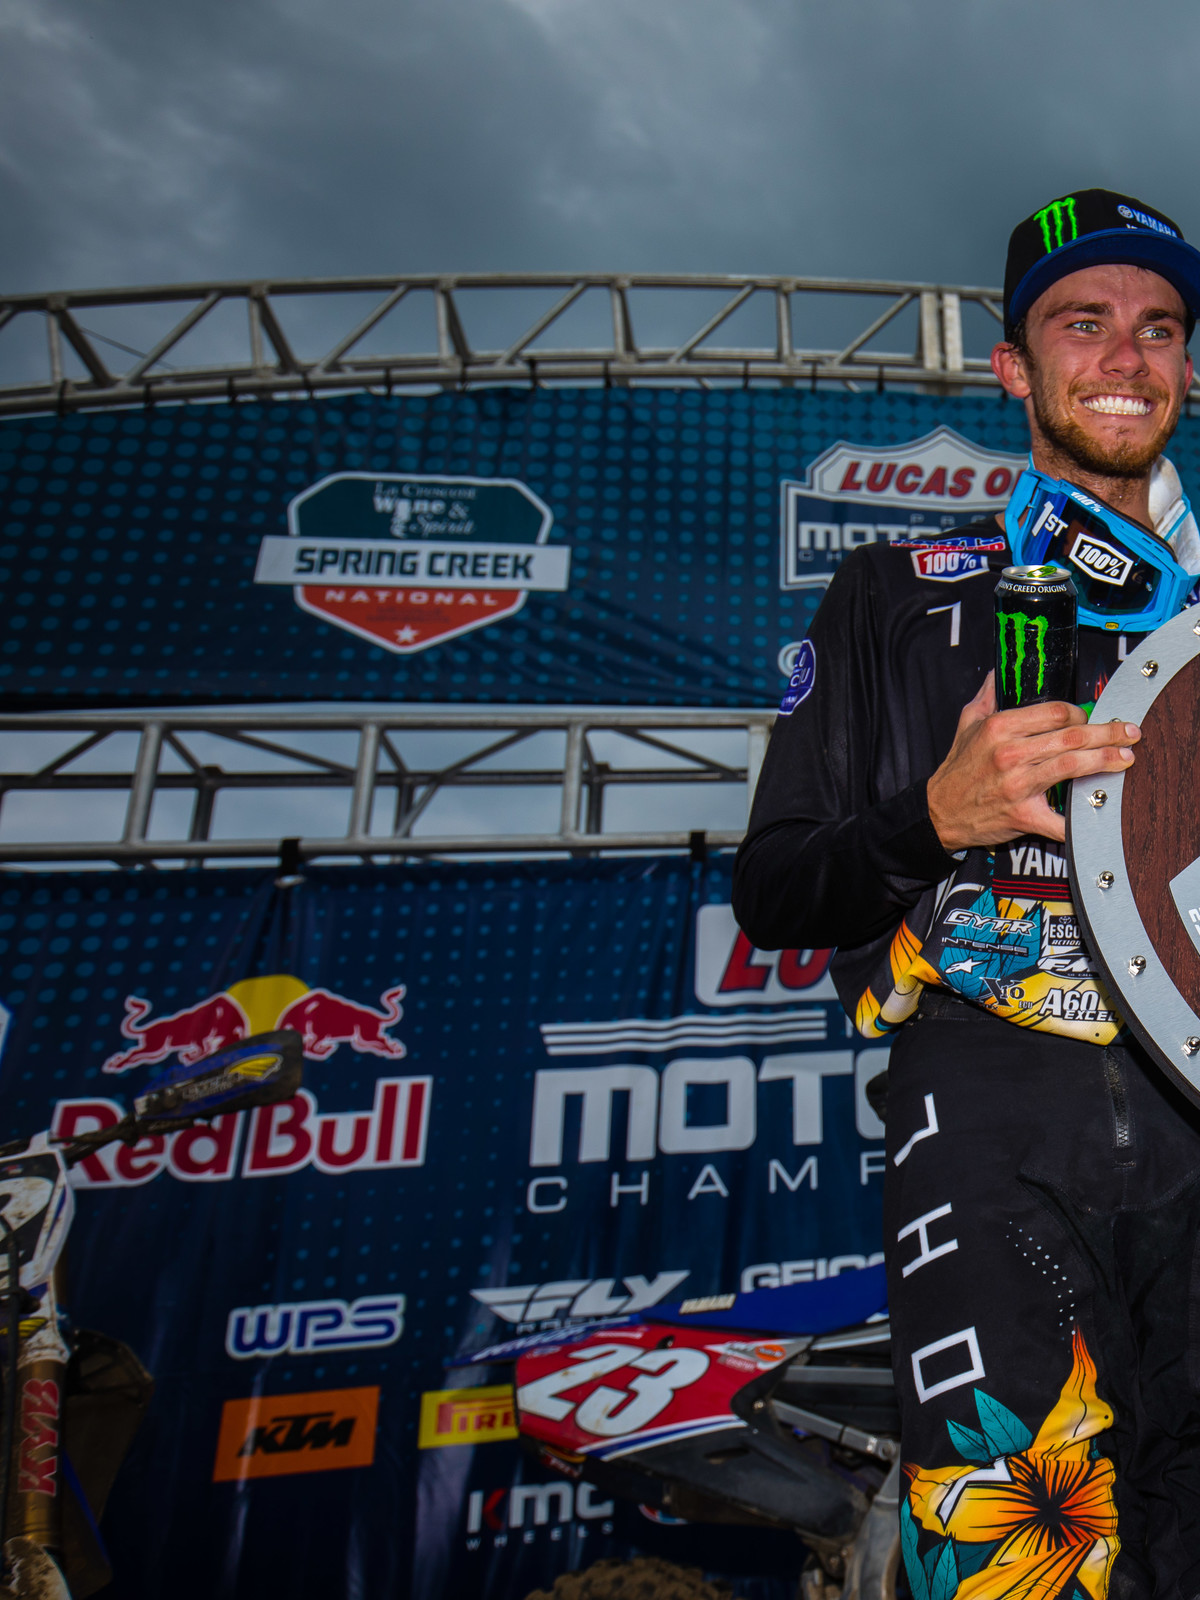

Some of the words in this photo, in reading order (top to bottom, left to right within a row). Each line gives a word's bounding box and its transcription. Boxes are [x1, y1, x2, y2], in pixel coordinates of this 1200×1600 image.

[1132, 209, 1178, 238] YAMAHA
[839, 461, 976, 498] LUCAS
[448, 502, 470, 520] &
[1031, 501, 1069, 537] 1ST
[294, 548, 419, 577] SPRING
[427, 552, 533, 580] CREEK
[922, 551, 978, 575] 100%
[1077, 543, 1128, 578] 100%
[324, 589, 499, 607] NATIONAL
[1012, 584, 1037, 593] CREED
[1037, 584, 1067, 594] ORIGINS
[943, 908, 1037, 936] GYTR
[942, 937, 1029, 953] INTENSE
[1038, 988, 1100, 1017] A60
[1063, 1010, 1119, 1022] EXCEL
[52, 1098, 244, 1188] Red
[243, 1075, 433, 1178] Bull
[469, 1270, 690, 1323] FLY
[228, 1296, 404, 1357] WPS
[517, 1343, 710, 1437] 23
[18, 1377, 61, 1497] KYB
[238, 1411, 356, 1459] KTM
